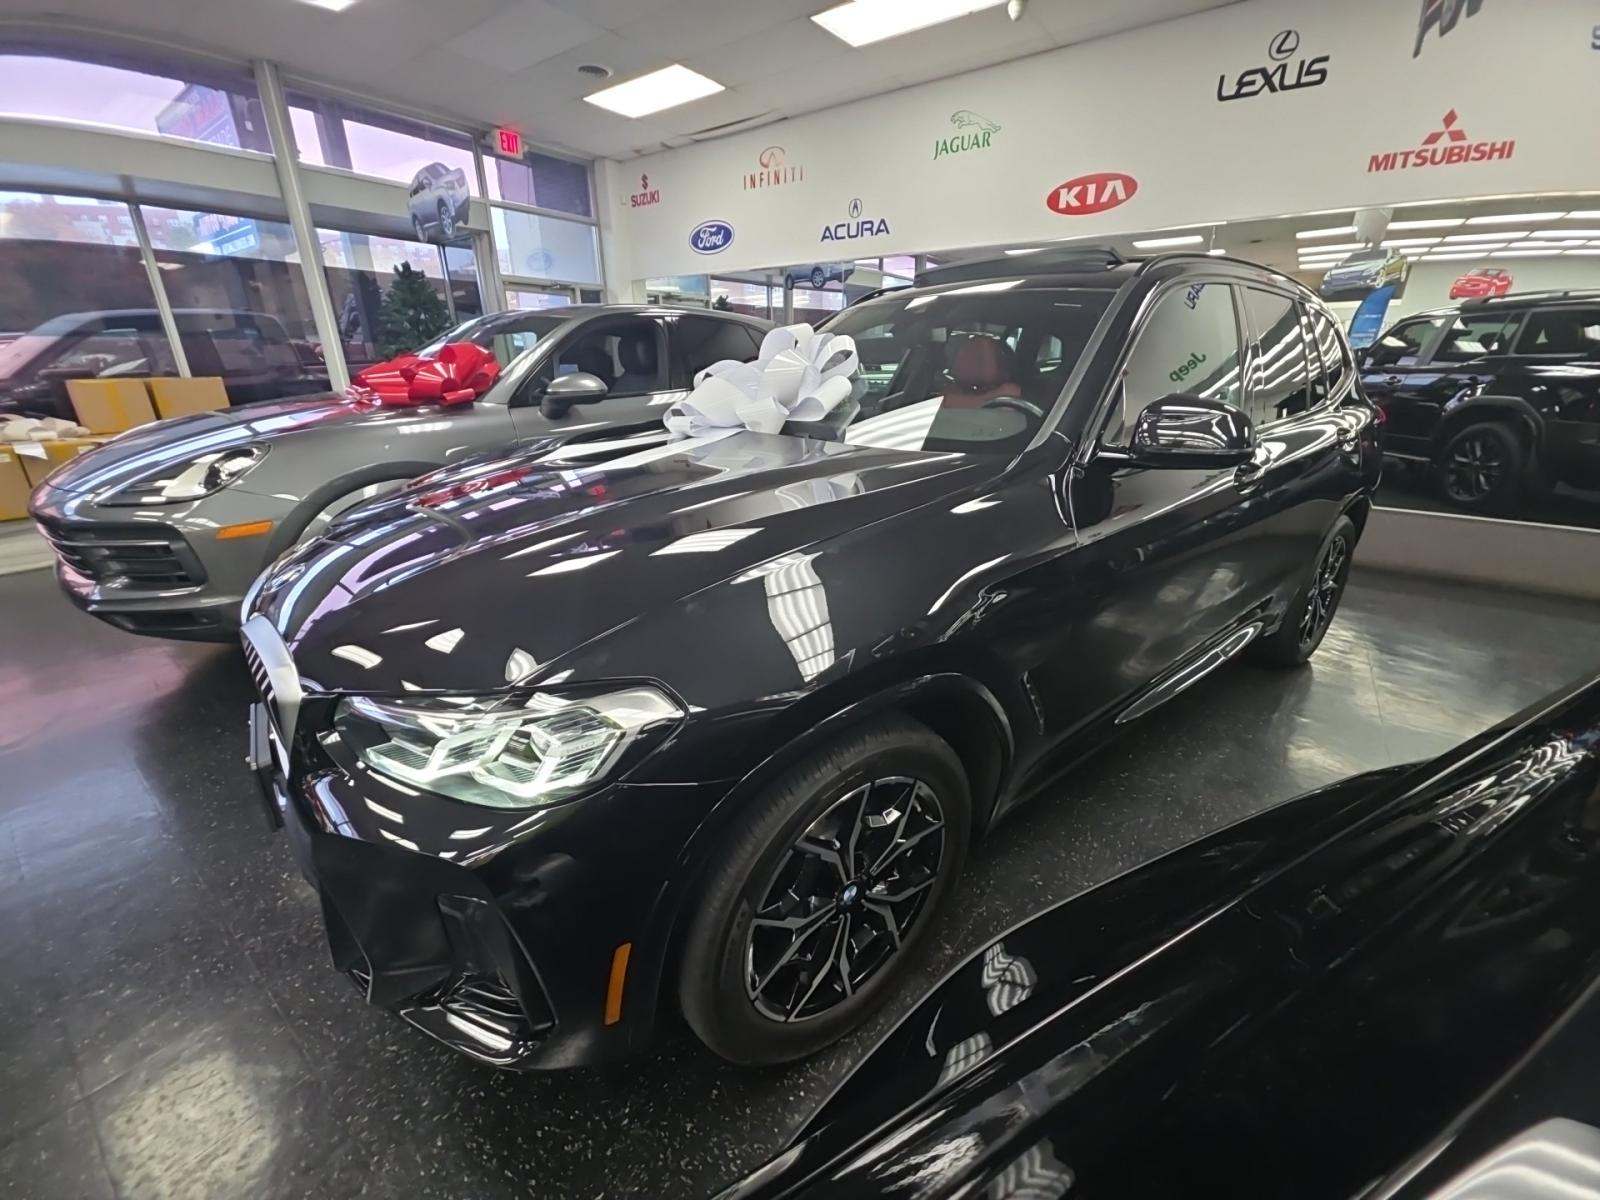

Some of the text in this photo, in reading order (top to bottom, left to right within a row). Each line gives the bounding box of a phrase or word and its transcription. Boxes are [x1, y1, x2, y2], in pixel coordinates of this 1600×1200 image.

[1217, 54, 1330, 101] LEXUS
[499, 131, 519, 155] EXIT
[934, 134, 991, 160] JAGUAR
[1367, 140, 1515, 172] MITSUBISHI
[743, 166, 803, 190] INFINITI
[630, 190, 660, 207] SUZUKI
[1058, 181, 1126, 209] KIA
[698, 226, 725, 247] Ford
[820, 219, 890, 242] ACURA
